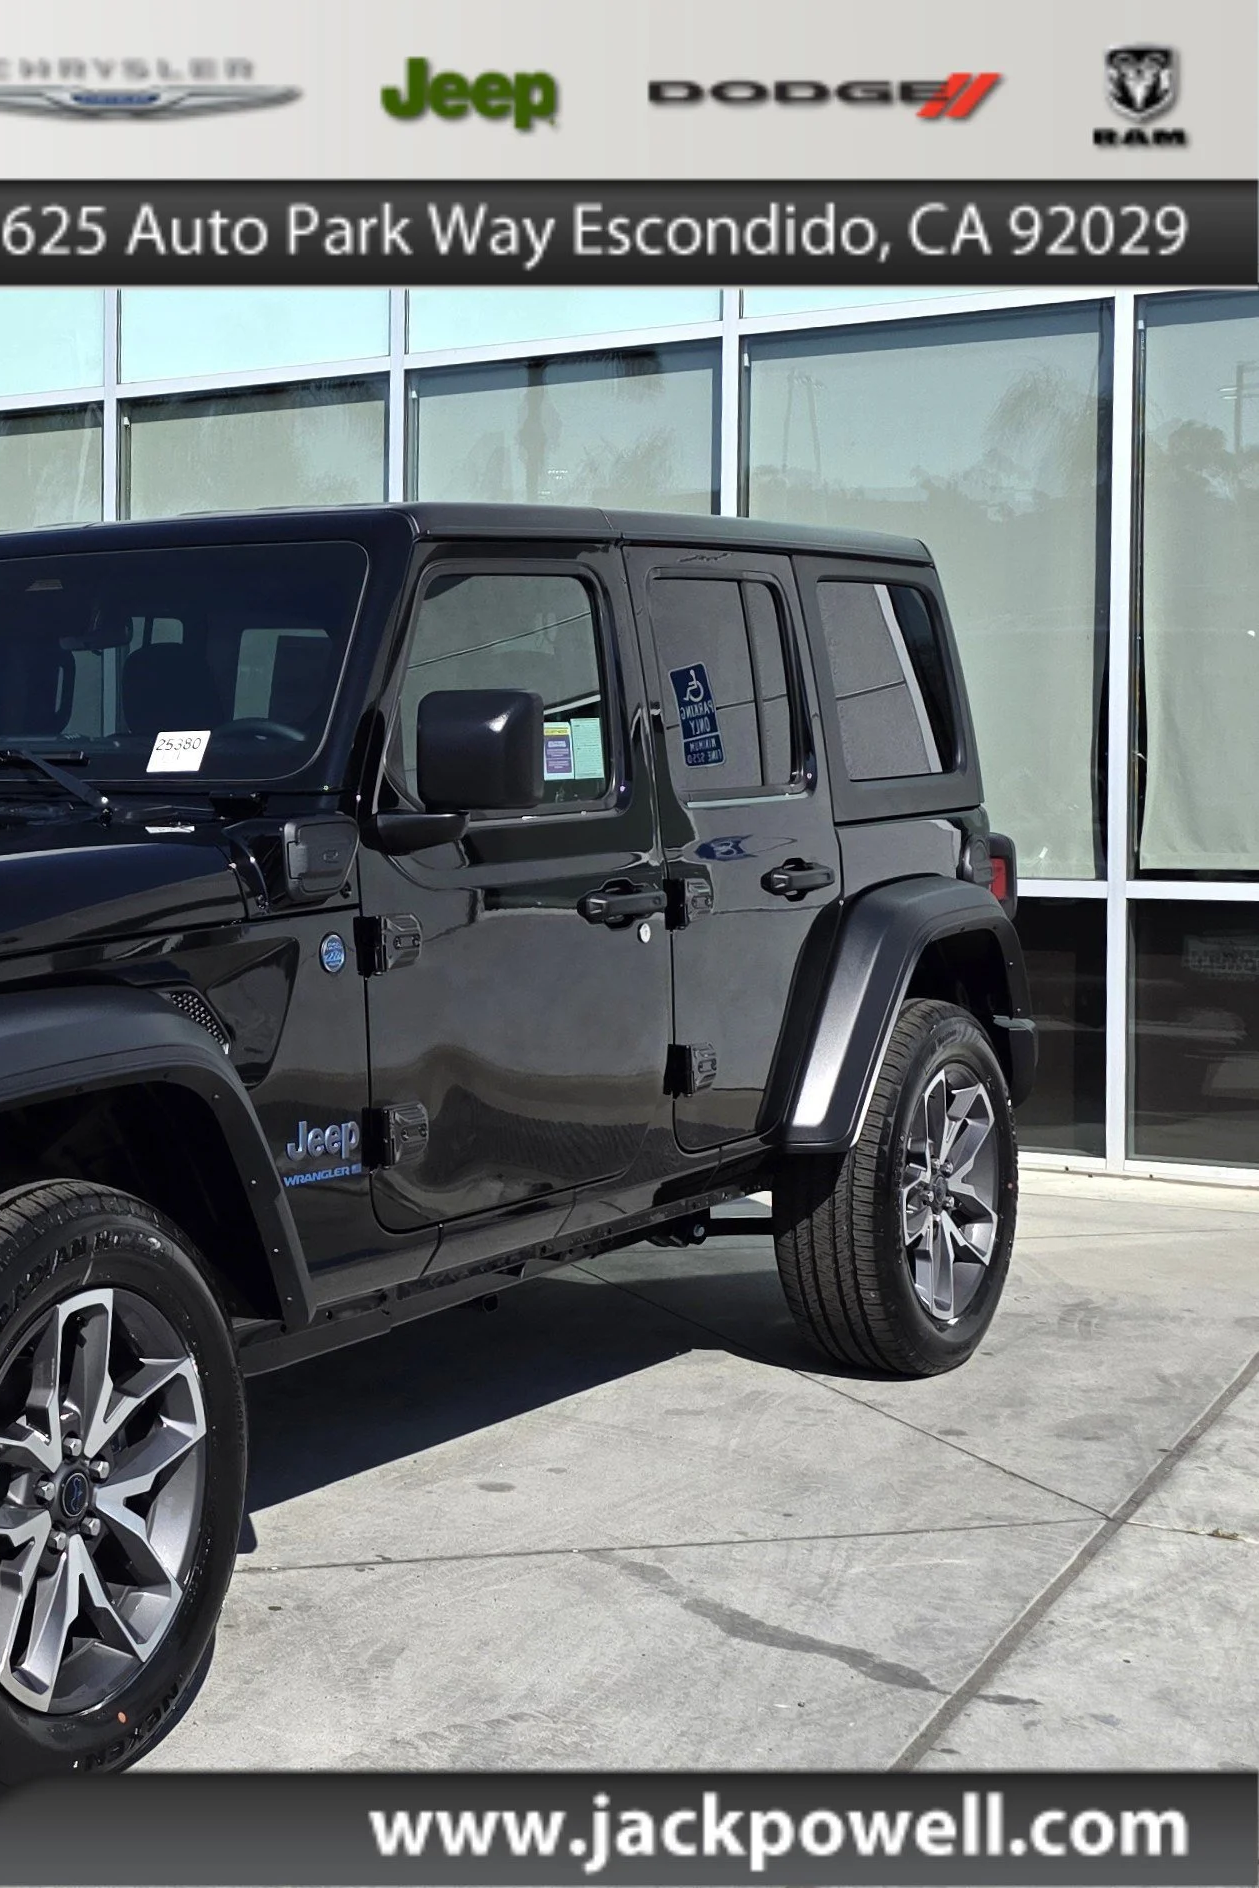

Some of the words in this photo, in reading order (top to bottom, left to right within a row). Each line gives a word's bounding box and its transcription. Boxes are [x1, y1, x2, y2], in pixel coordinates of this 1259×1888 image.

[156, 737, 202, 751] 25380
[286, 1120, 360, 1161] Jeep
[282, 1165, 351, 1188] WRANGLER
